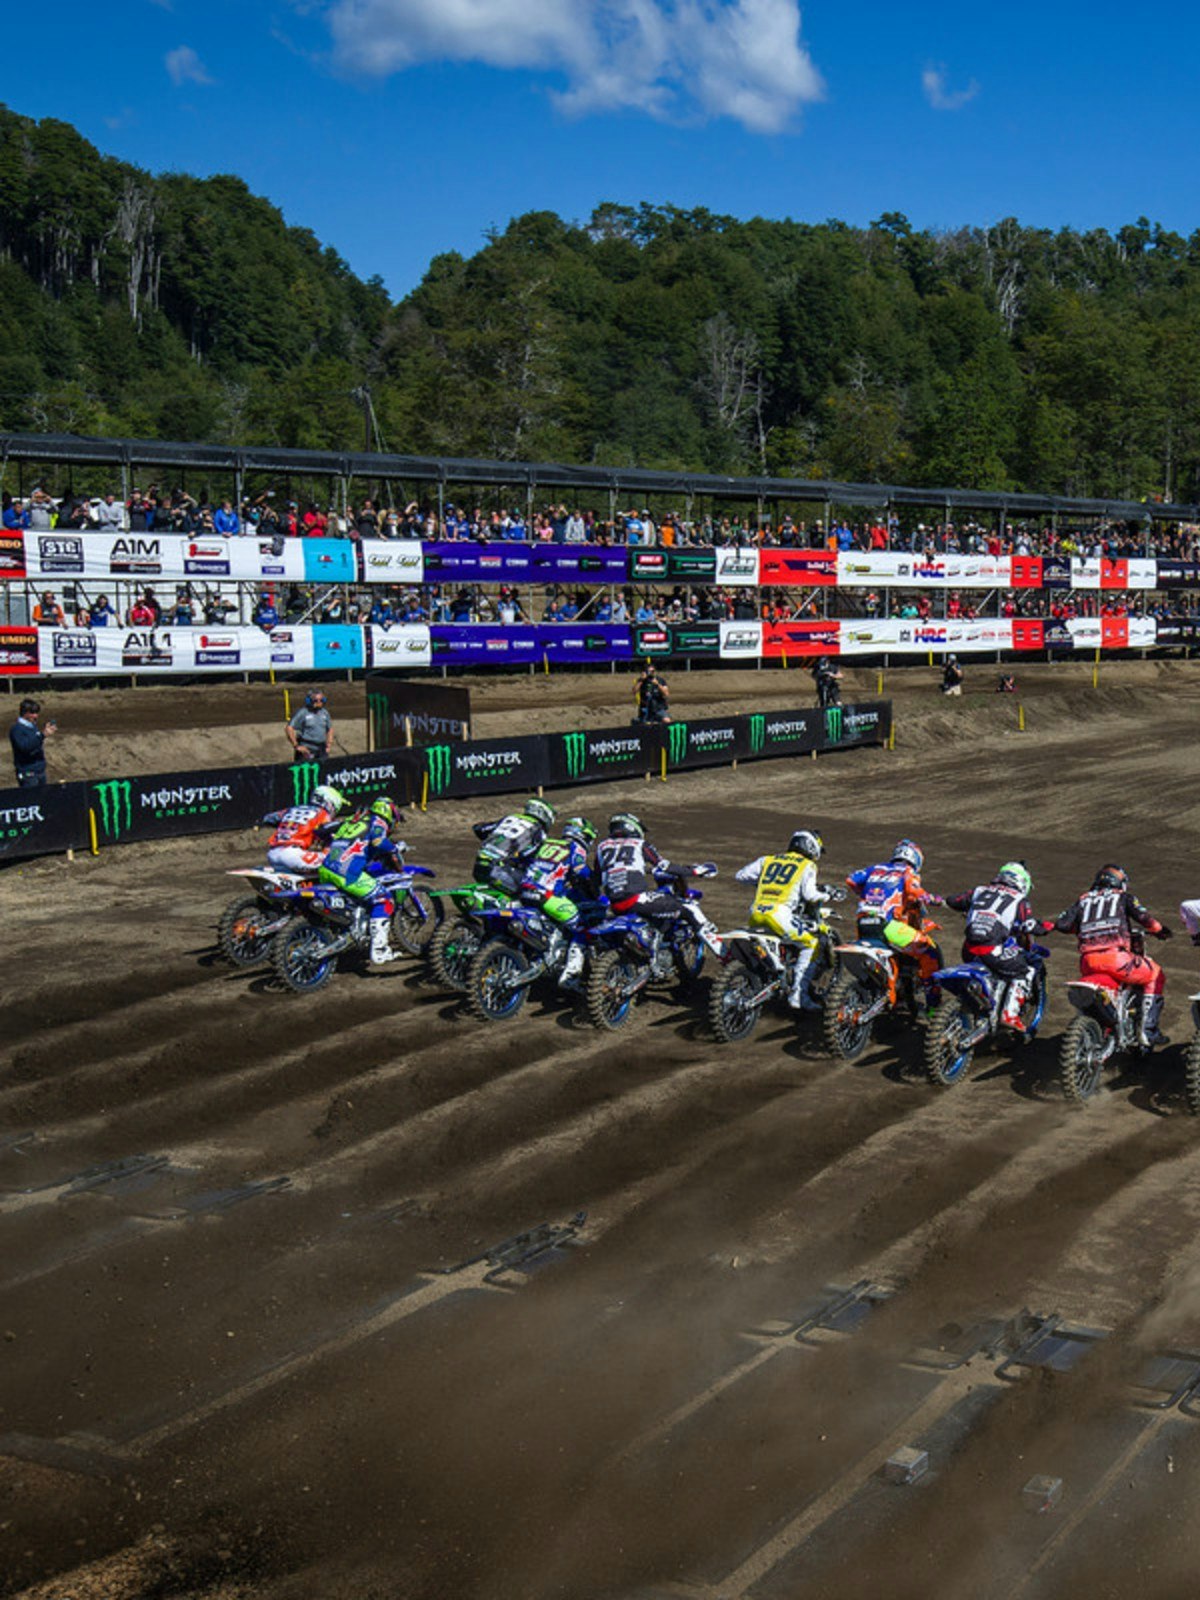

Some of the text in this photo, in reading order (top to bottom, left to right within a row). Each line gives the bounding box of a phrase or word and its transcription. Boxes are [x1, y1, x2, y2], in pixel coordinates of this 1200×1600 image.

[111, 538, 160, 555] A1M
[913, 562, 945, 578] HRC
[914, 627, 947, 643] HRC
[843, 712, 879, 726] MONSTER
[767, 720, 807, 735] MONSTER
[690, 728, 735, 745] MONSTER
[772, 733, 801, 742] ENERGY
[589, 738, 641, 755] MONSTER
[696, 742, 730, 753] ENERGY
[456, 751, 521, 771] MONSTER
[597, 753, 635, 764] ENERGY
[326, 765, 397, 787] MONSTER
[466, 767, 512, 778] ENERGY
[141, 785, 232, 809] MONSTER
[155, 803, 220, 819] ENERGY
[762, 861, 798, 885] 99
[973, 890, 1016, 915] 91
[1080, 893, 1120, 923] 777
